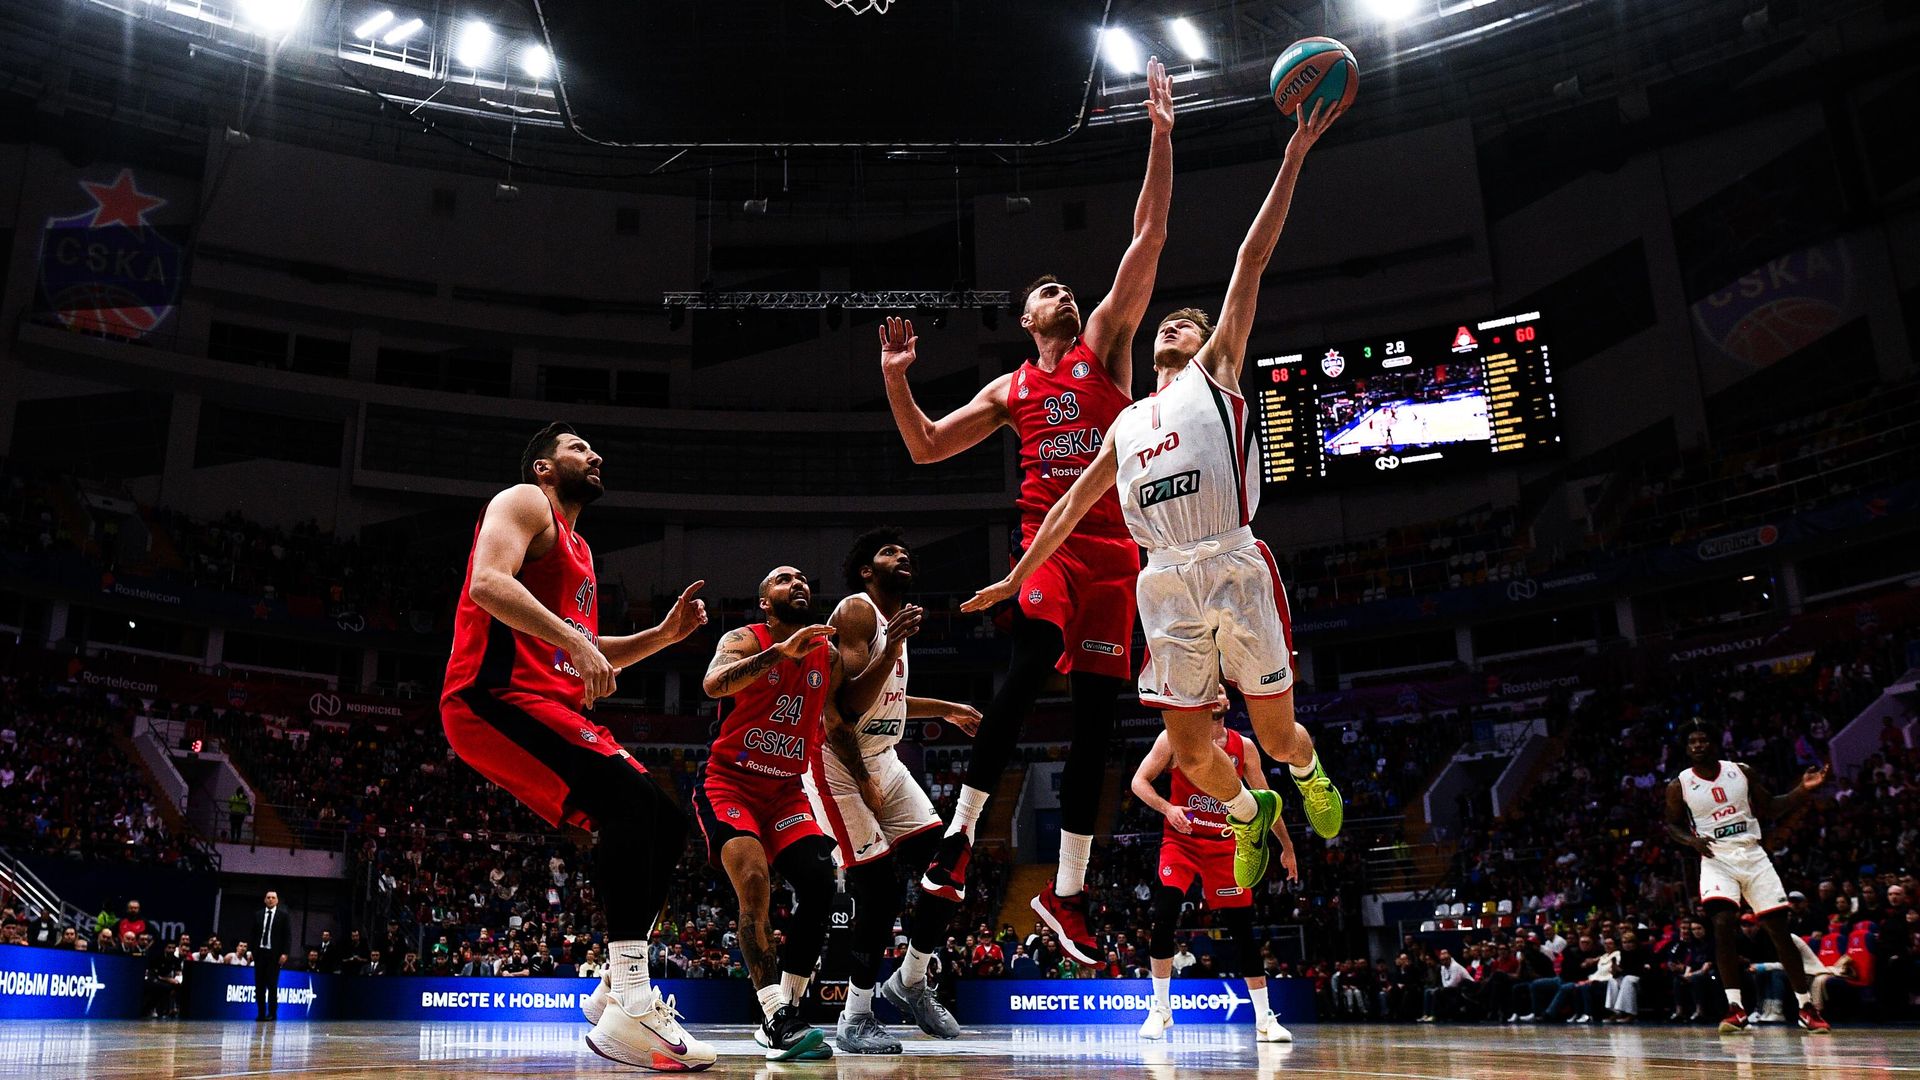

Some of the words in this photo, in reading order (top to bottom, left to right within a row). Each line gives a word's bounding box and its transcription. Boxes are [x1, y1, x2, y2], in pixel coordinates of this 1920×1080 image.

[1278, 64, 1320, 107] Wilson
[56, 237, 166, 286] CSKA
[1515, 326, 1535, 343] 60
[1363, 346, 1372, 358] 3
[1386, 340, 1406, 355] 2.8
[1271, 368, 1289, 382] 68
[1044, 391, 1080, 425] 33
[1151, 403, 1161, 430] 1
[1039, 428, 1104, 460] CSKA
[1051, 466, 1086, 477] Rostel
[1141, 473, 1198, 505] PARI
[115, 583, 181, 604] Rostelecom
[575, 576, 595, 617] 41
[1292, 619, 1347, 632] ostelecom
[1085, 641, 1112, 653] Winline
[1668, 637, 1763, 663] АЭРОФЛОТ
[83, 671, 159, 694] Rostelecom
[1502, 675, 1581, 695] Rostelecom
[346, 703, 403, 717] NORNICKEL
[769, 695, 804, 725] 24
[862, 720, 900, 735] PAR
[743, 728, 805, 760] CSKA
[745, 760, 797, 777] Rosteleco
[1711, 787, 1728, 803] 0
[1188, 794, 1228, 815] CSKA
[777, 815, 803, 829] Winline
[1192, 817, 1228, 829] Rostelecom
[629, 965, 638, 973] 41
[0, 971, 49, 996] НОВЫМ
[226, 984, 256, 1003] ВМЕСТЕ
[421, 992, 491, 1008] ВМЕСТЕ
[494, 992, 506, 1008] К
[509, 993, 575, 1008] НОВЫМ
[1010, 995, 1081, 1010] ВМЕСТЕ
[1084, 995, 1096, 1010] К
